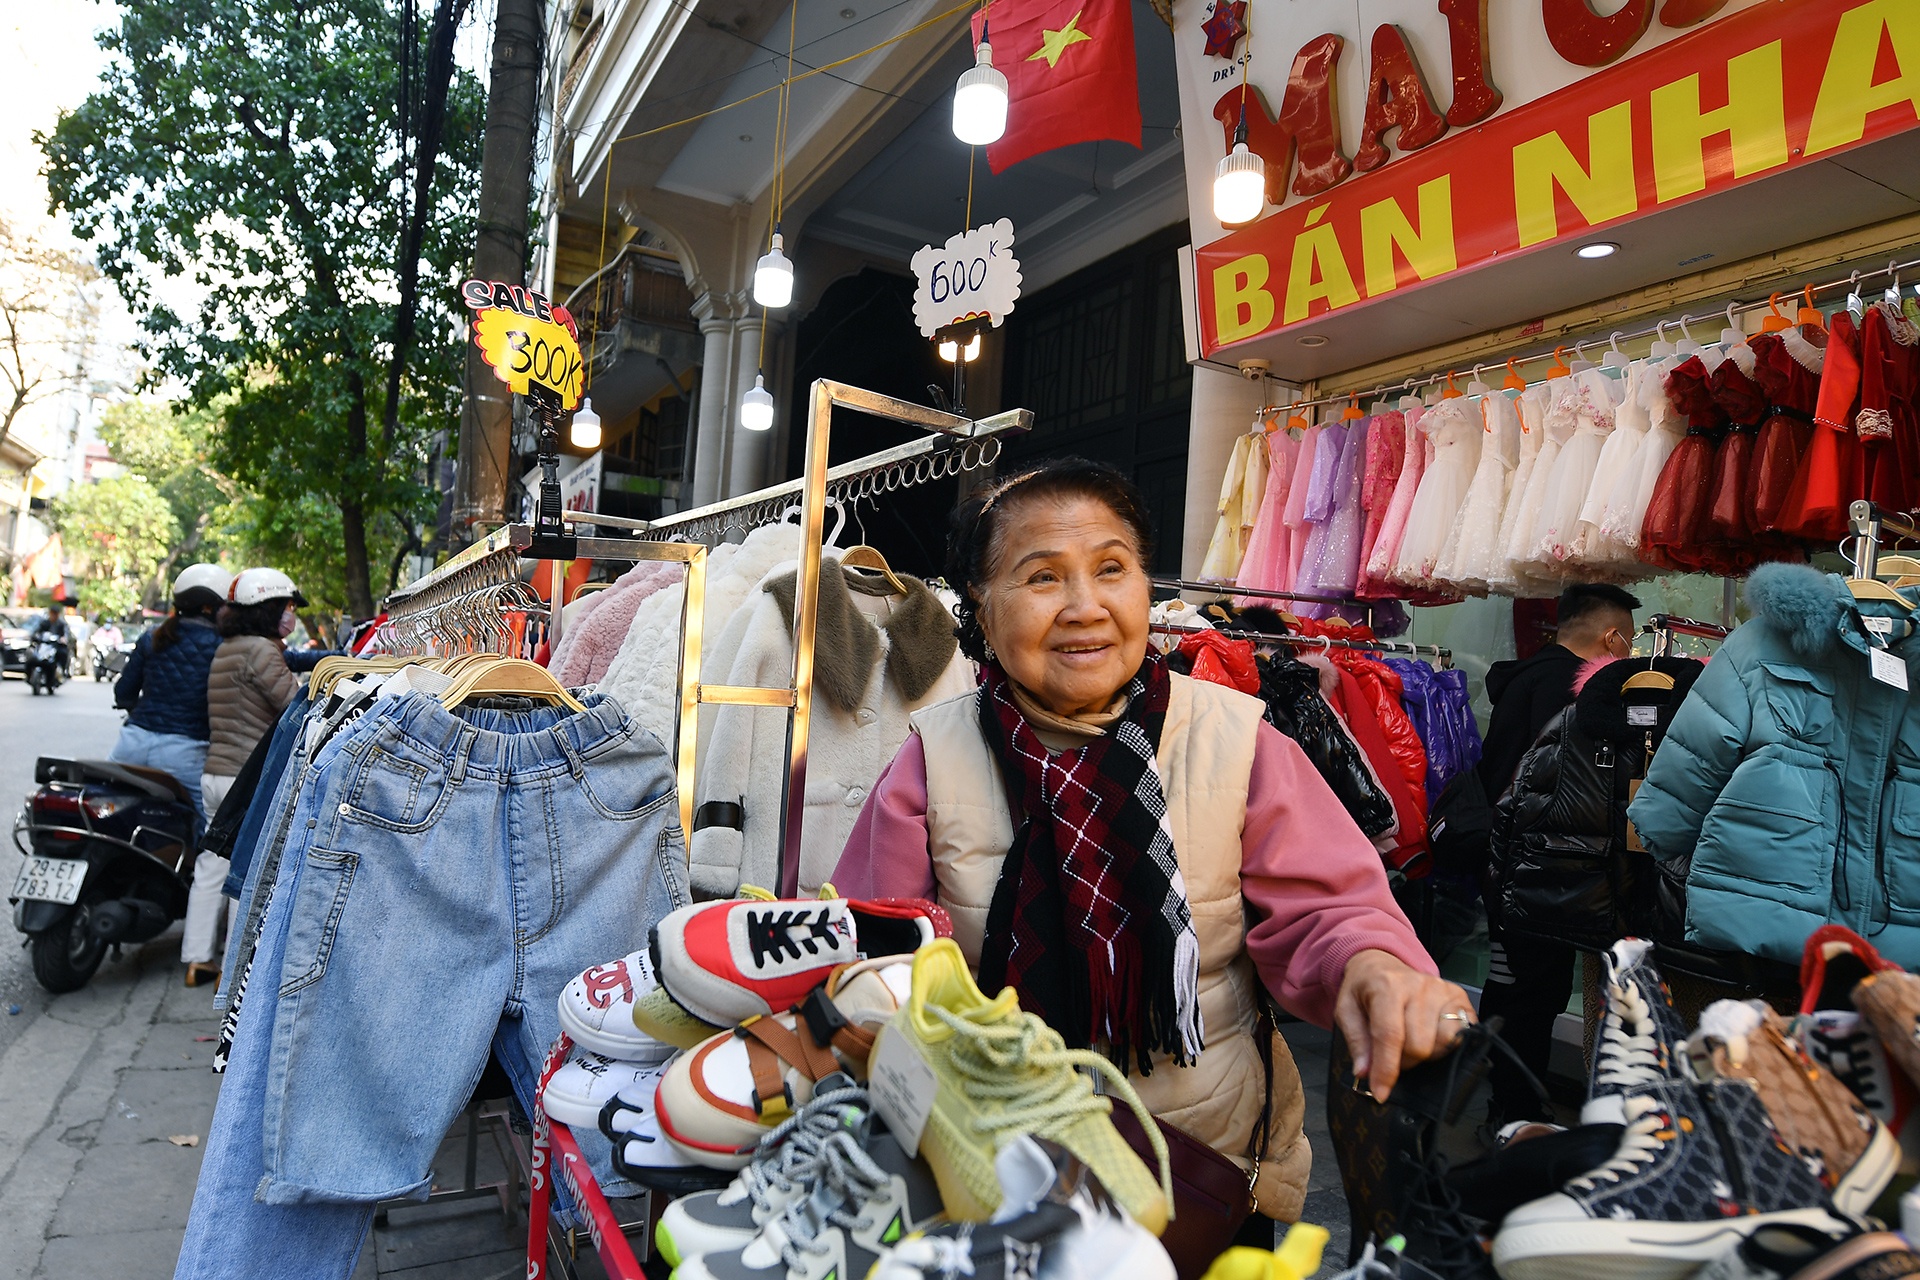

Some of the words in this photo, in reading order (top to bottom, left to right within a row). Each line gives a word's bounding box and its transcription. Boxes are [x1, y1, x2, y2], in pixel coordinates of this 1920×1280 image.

[1212, 175, 1457, 346] BÁN
[464, 280, 552, 323] SALE
[505, 329, 581, 400] 300K
[17, 877, 75, 900] 783.12
